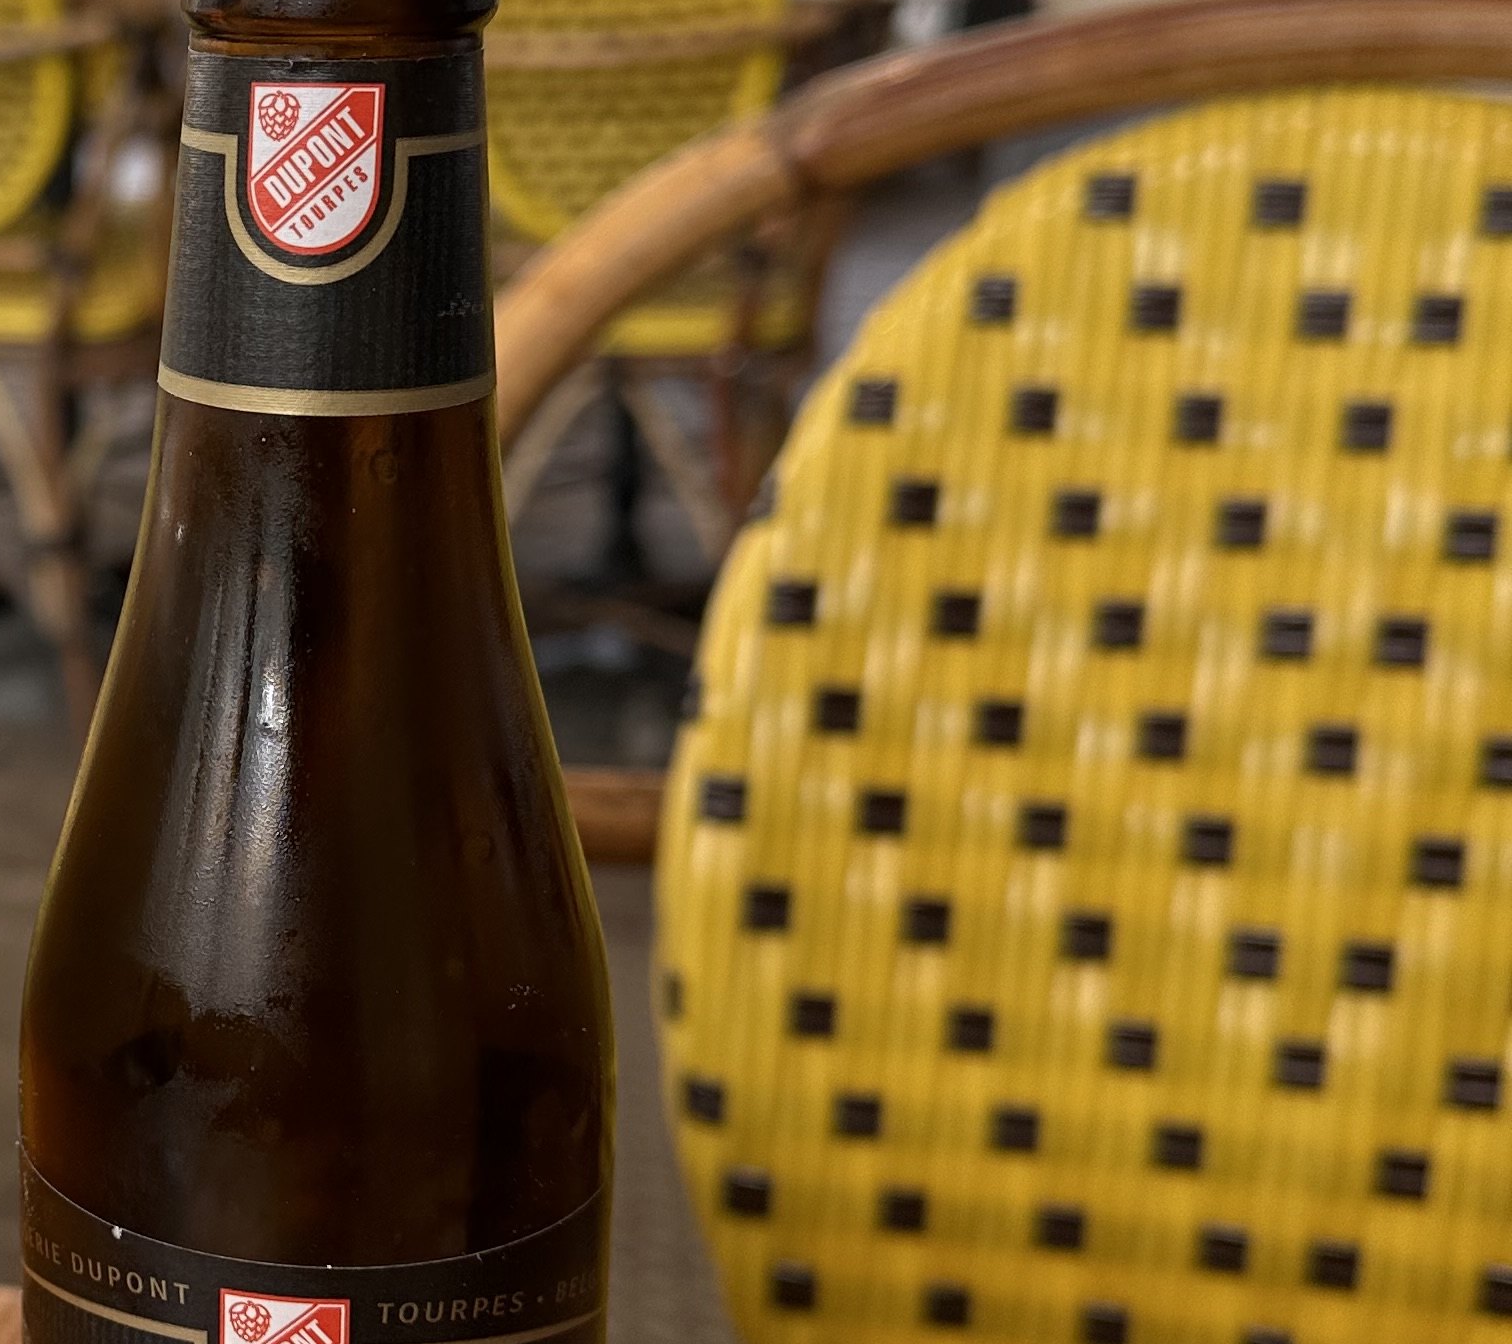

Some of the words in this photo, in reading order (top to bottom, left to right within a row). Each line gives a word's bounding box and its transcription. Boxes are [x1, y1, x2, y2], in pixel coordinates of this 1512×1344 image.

[263, 105, 366, 209] DUPONT
[289, 165, 369, 240] TOURPES
[71, 1251, 190, 1305] DUPONT
[378, 1290, 524, 1326] TOURPES
